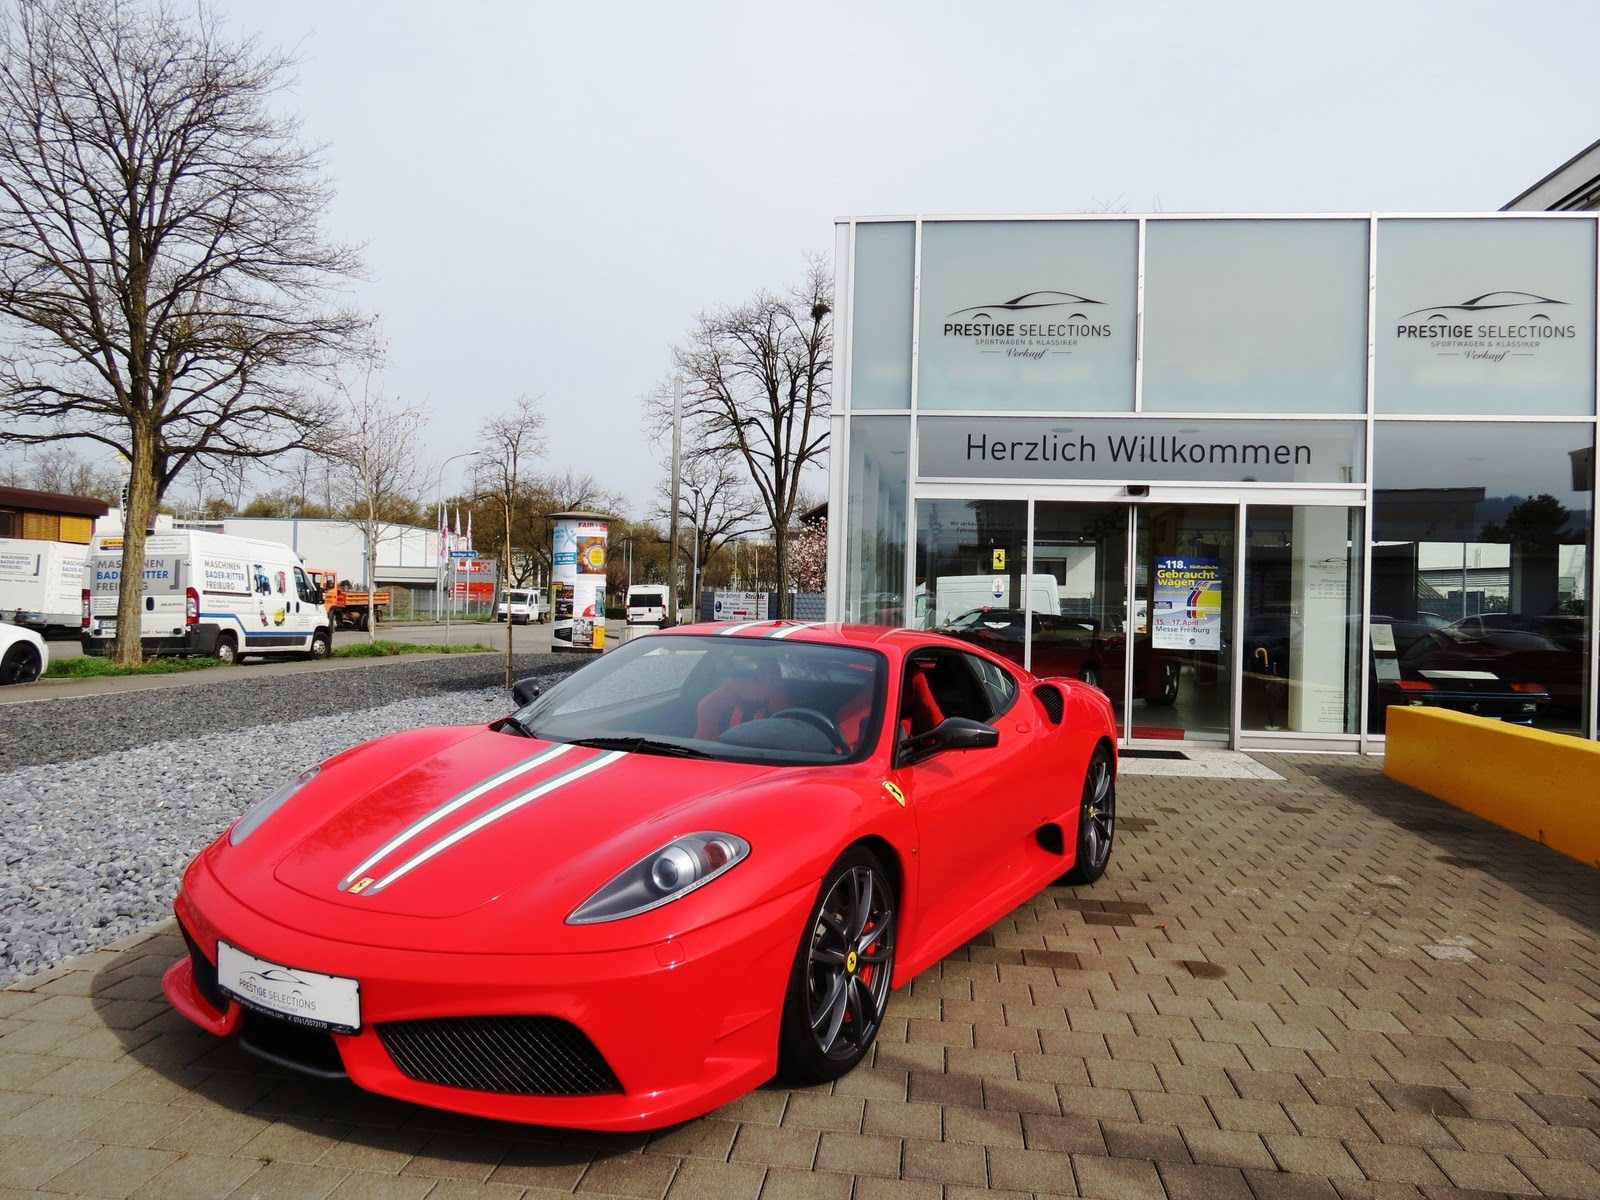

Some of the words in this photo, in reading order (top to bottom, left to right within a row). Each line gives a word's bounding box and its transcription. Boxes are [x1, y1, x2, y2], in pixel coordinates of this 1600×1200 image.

[944, 323, 1015, 336] PRESTIGE
[1019, 324, 1112, 337] SELECTIONS
[1397, 325, 1473, 338] PRESTIGE
[1478, 325, 1576, 338] SELECTIONS
[1431, 340, 1485, 348] SPORTWAGEN
[1005, 348, 1050, 360] Verkauf
[1463, 350, 1511, 362] Verkauf
[966, 434, 1096, 462] Herzlich
[1107, 435, 1312, 465] Willkommen
[97, 559, 164, 569] MASNEN
[204, 560, 242, 570] MASCHINEN
[1166, 560, 1187, 570] 118.
[96, 570, 169, 580] BADITTER
[205, 570, 245, 581] BADER-RITTER
[1157, 570, 1218, 579] Gebraucht-
[96, 582, 149, 591] FREIG
[205, 580, 236, 591] FREIBURG
[1158, 579, 1195, 588] wagen
[745, 592, 765, 600] Steile
[1182, 620, 1199, 628] April
[1180, 627, 1210, 635] Freiburg
[239, 978, 267, 998] PRESTIGE
[268, 991, 317, 1011] SELECTIONS
